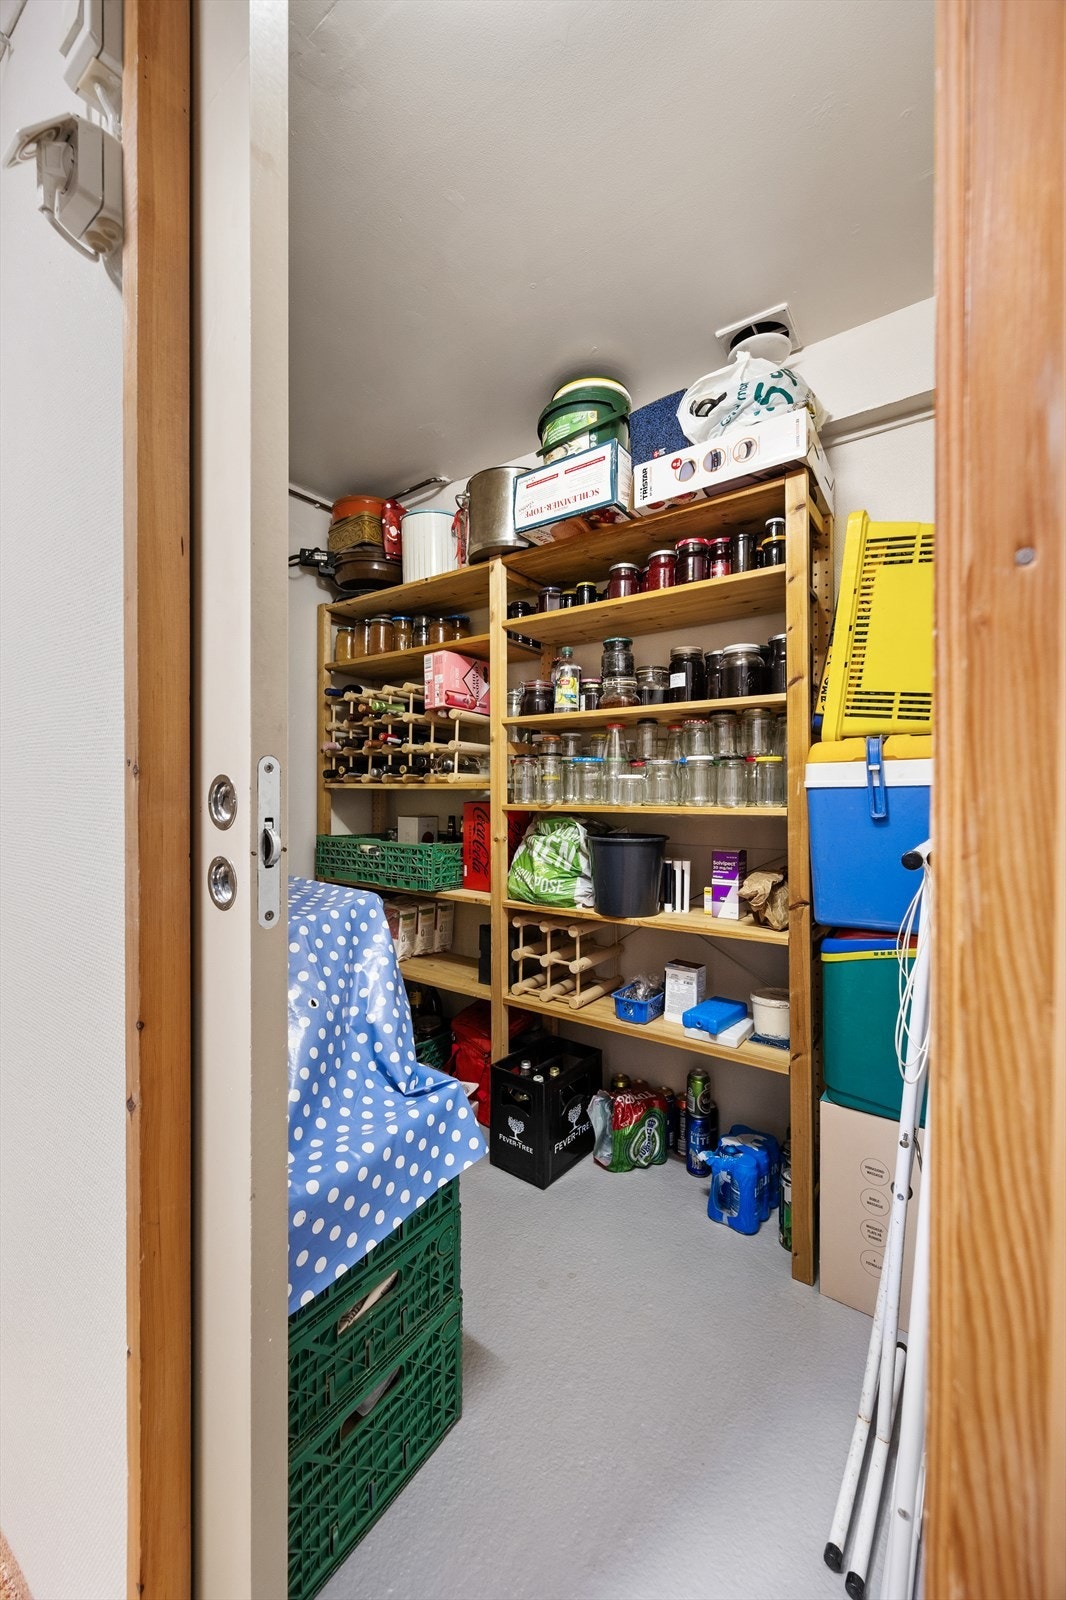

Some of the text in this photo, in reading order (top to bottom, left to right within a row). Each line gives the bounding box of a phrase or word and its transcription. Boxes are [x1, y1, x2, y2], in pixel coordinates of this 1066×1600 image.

[524, 487, 600, 518] SCHLEMMER-TOPF
[498, 1133, 534, 1155] FEVER-TREE
[554, 1121, 593, 1154] FEVER-TRE
